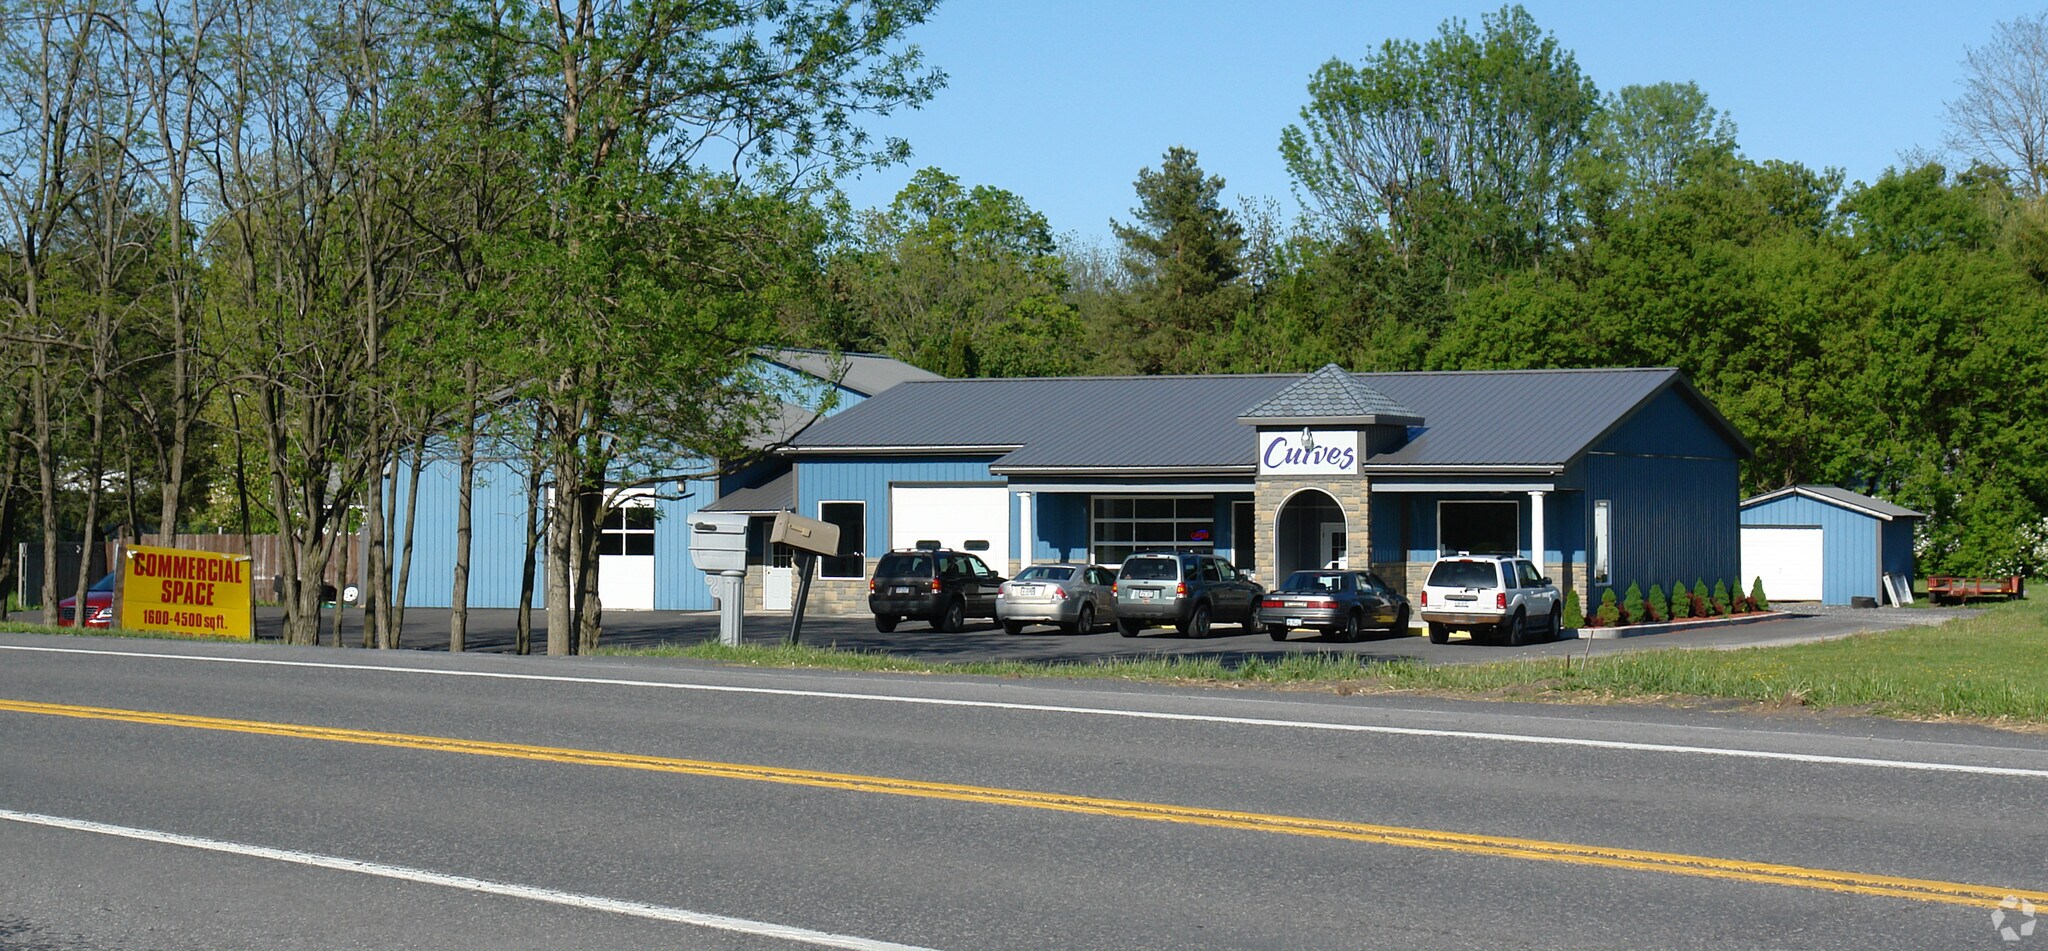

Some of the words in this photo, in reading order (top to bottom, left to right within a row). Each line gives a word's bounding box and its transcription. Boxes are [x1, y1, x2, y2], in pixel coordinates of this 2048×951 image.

[1263, 436, 1354, 470] Curves
[133, 553, 242, 583] COMMERCIAL
[161, 580, 214, 606] SPACE
[143, 609, 202, 627] 1600-4500
